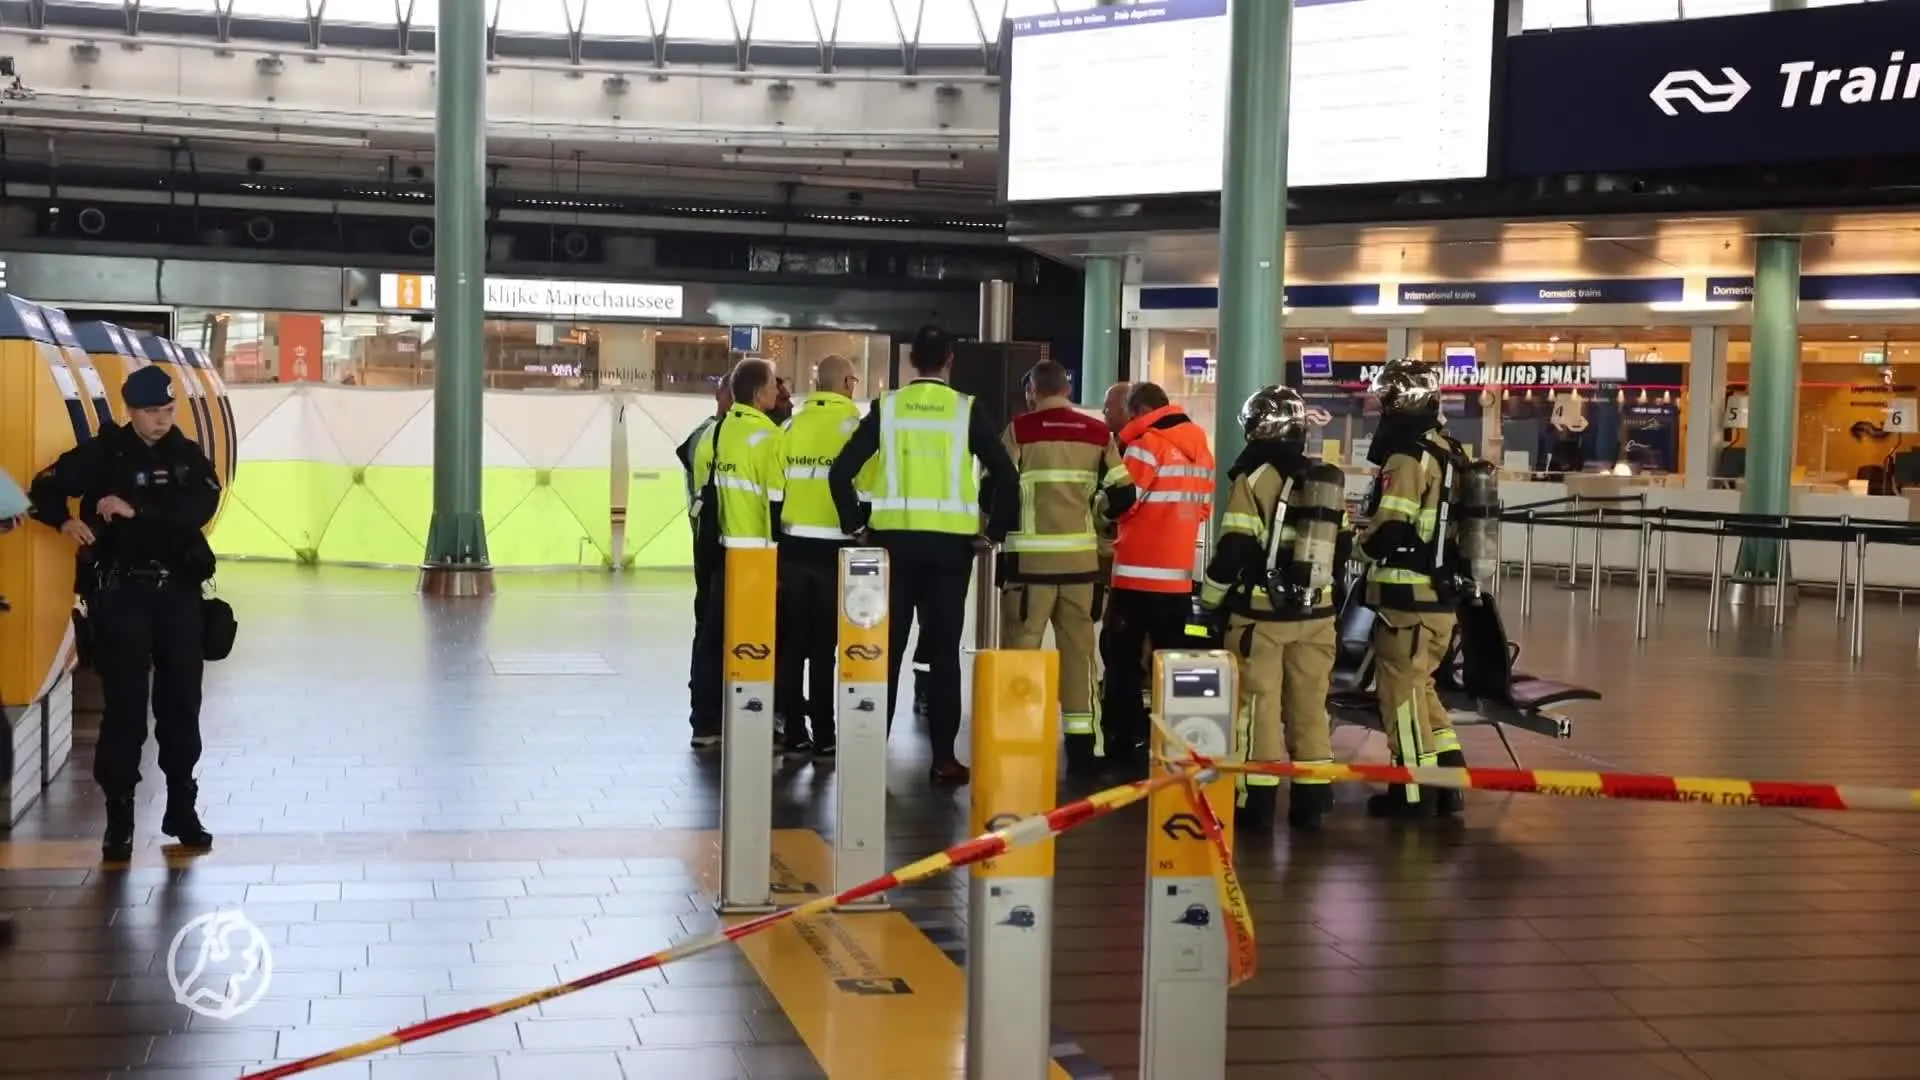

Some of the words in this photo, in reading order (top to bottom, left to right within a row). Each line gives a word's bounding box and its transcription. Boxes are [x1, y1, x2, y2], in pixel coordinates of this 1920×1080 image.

[545, 287, 675, 310] Marechaussee
[1729, 407, 1738, 420] 5
[1891, 411, 1902, 426] 6
[1159, 861, 1174, 869] NS
